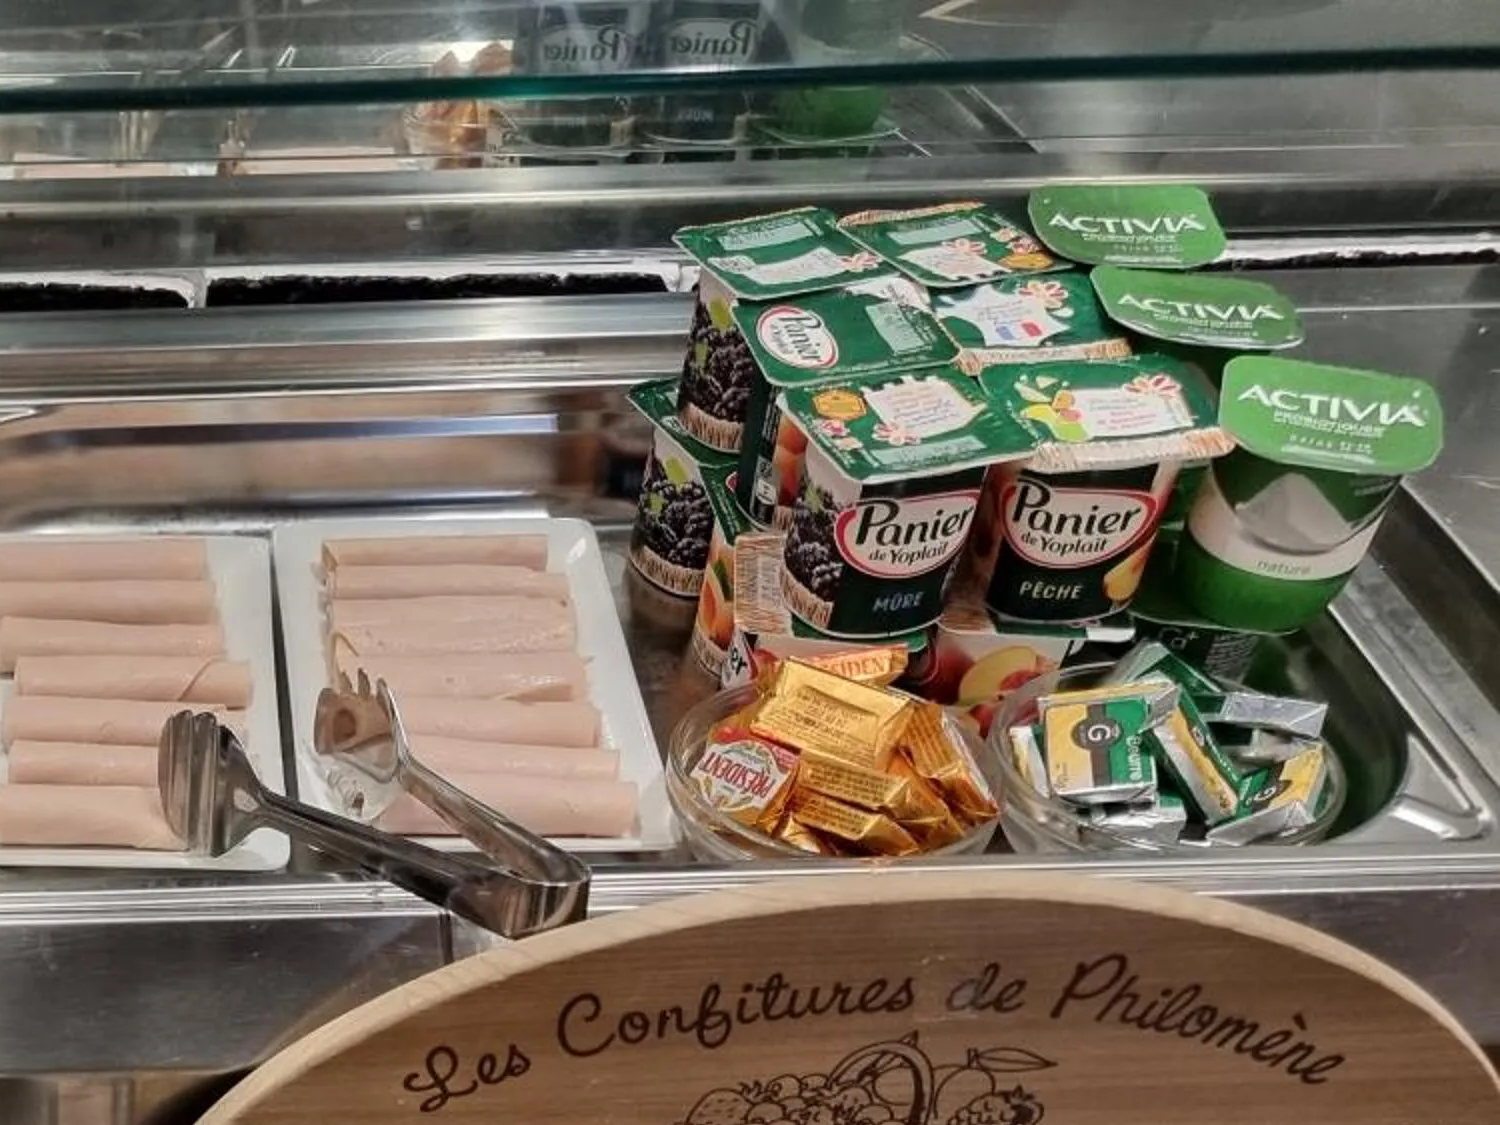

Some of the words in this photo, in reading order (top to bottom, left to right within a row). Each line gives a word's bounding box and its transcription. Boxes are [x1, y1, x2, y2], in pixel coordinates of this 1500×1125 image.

[1049, 213, 1206, 233] ACTIVIA
[1118, 294, 1284, 320] ACTIVIA
[1238, 384, 1426, 427] ACTIVIA
[1012, 479, 1141, 536] Panier
[856, 499, 975, 546] Panier
[868, 548, 887, 561] de
[890, 541, 949, 566] Yoplait
[1021, 531, 1039, 544] de
[1041, 534, 1108, 556] Yoplait
[1257, 559, 1312, 575] nature
[873, 591, 924, 612] MÛRE
[1019, 580, 1083, 601] PÊCHE
[403, 1044, 531, 1112] Les
[556, 972, 916, 1057] Confitures
[945, 962, 1027, 1013] de
[1049, 953, 1348, 1085] Philomène
